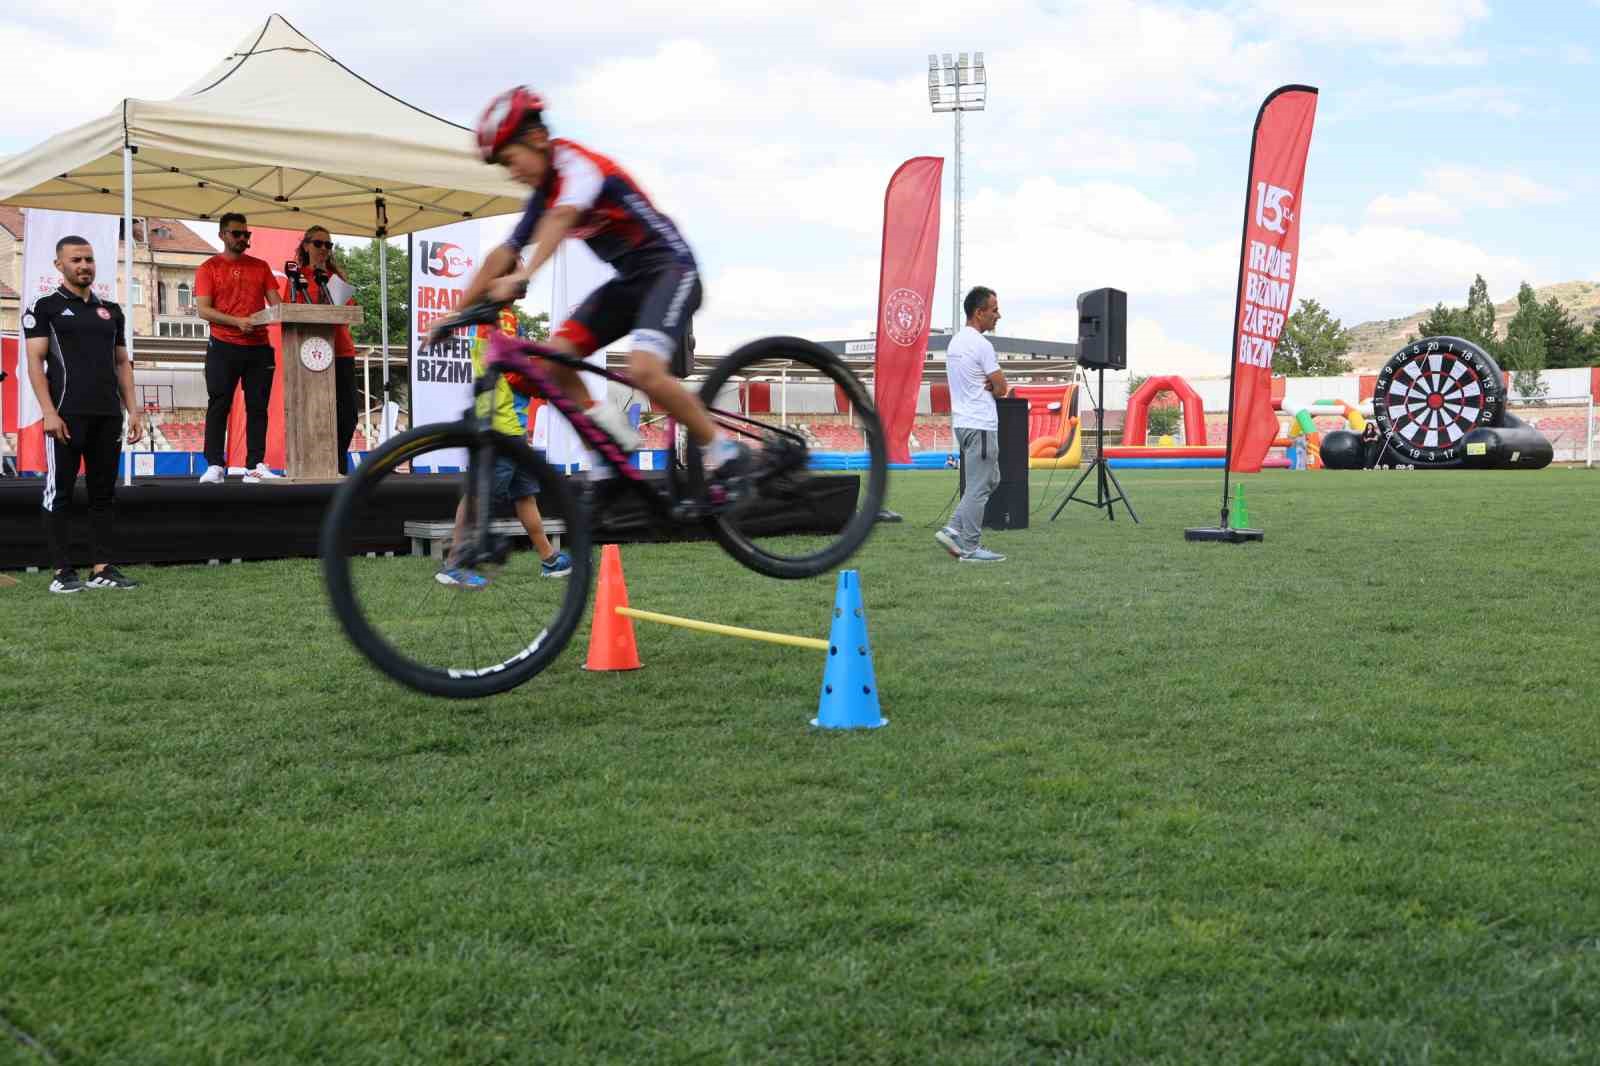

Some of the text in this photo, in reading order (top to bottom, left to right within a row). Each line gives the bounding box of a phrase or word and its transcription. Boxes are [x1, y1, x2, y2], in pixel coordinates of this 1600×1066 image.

[419, 240, 456, 278] 15
[417, 286, 465, 311] İRAD
[1243, 303, 1285, 338] ZAFER
[1413, 345, 1420, 354] 5
[1427, 342, 1439, 351] 20
